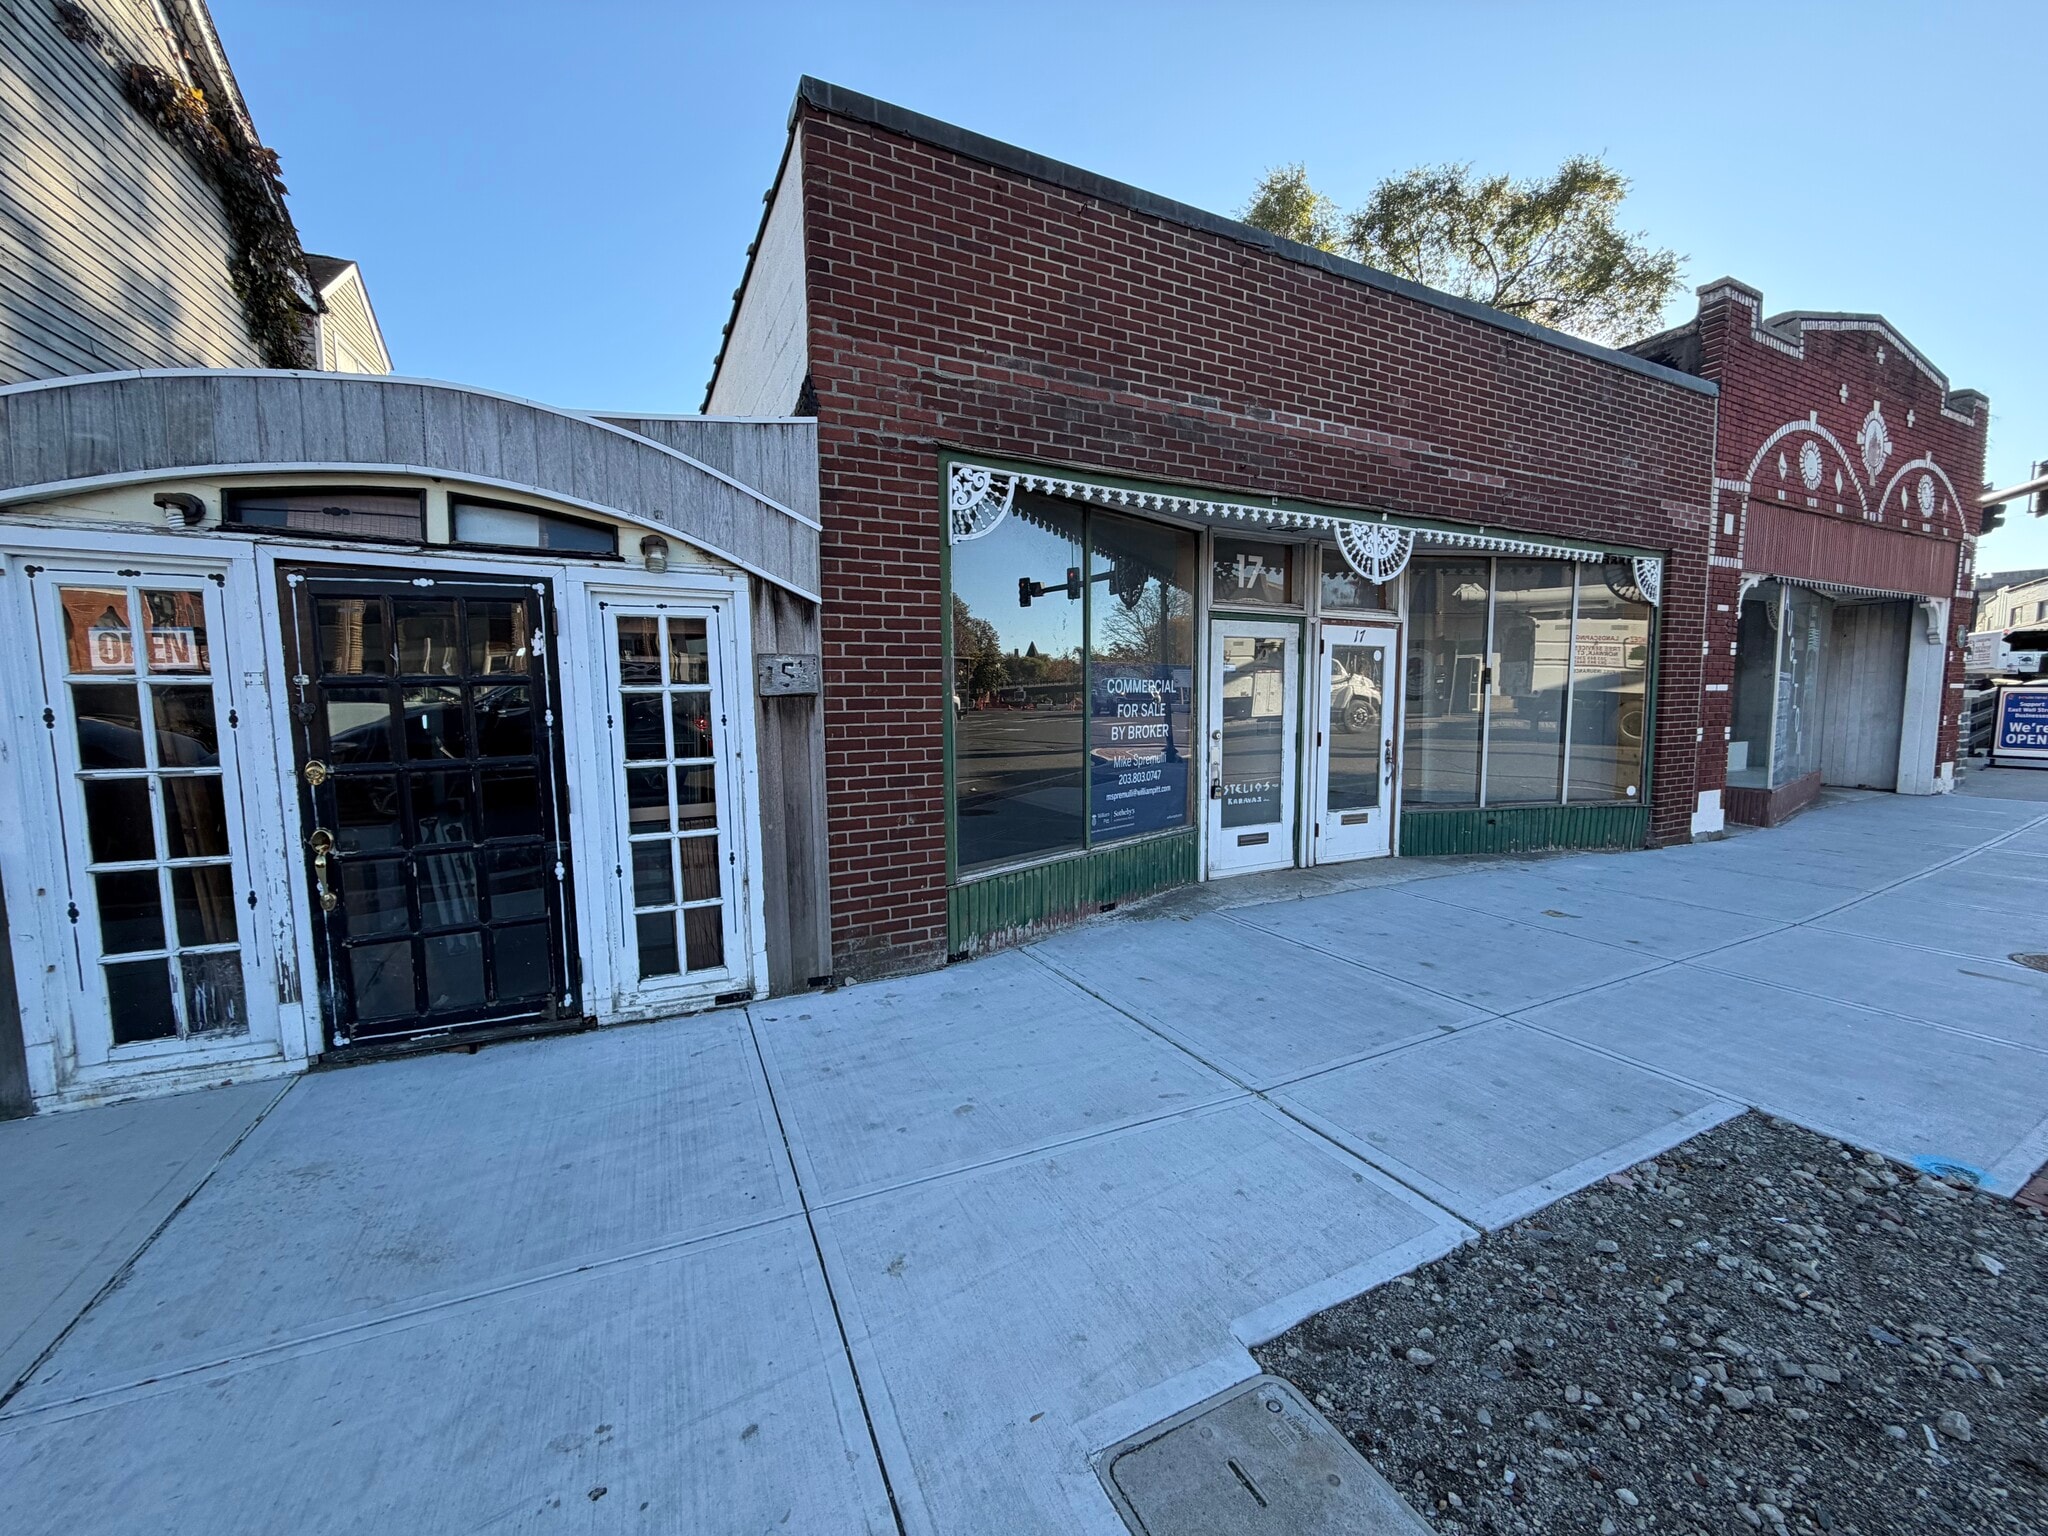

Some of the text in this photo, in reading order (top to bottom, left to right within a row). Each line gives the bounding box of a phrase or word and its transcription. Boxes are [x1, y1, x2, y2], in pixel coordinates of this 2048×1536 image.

[1236, 553, 1264, 589] 17
[1354, 629, 1366, 643] 17
[1107, 679, 1177, 694] COMMERCIAL
[1117, 702, 1166, 718] FOR SALE
[1111, 723, 1169, 741] BY BROKER
[2009, 722, 2048, 733] We're
[1113, 755, 1131, 769] Mike
[1118, 769, 1162, 786] 203.803.0747
[1223, 781, 1270, 796] STELIOS
